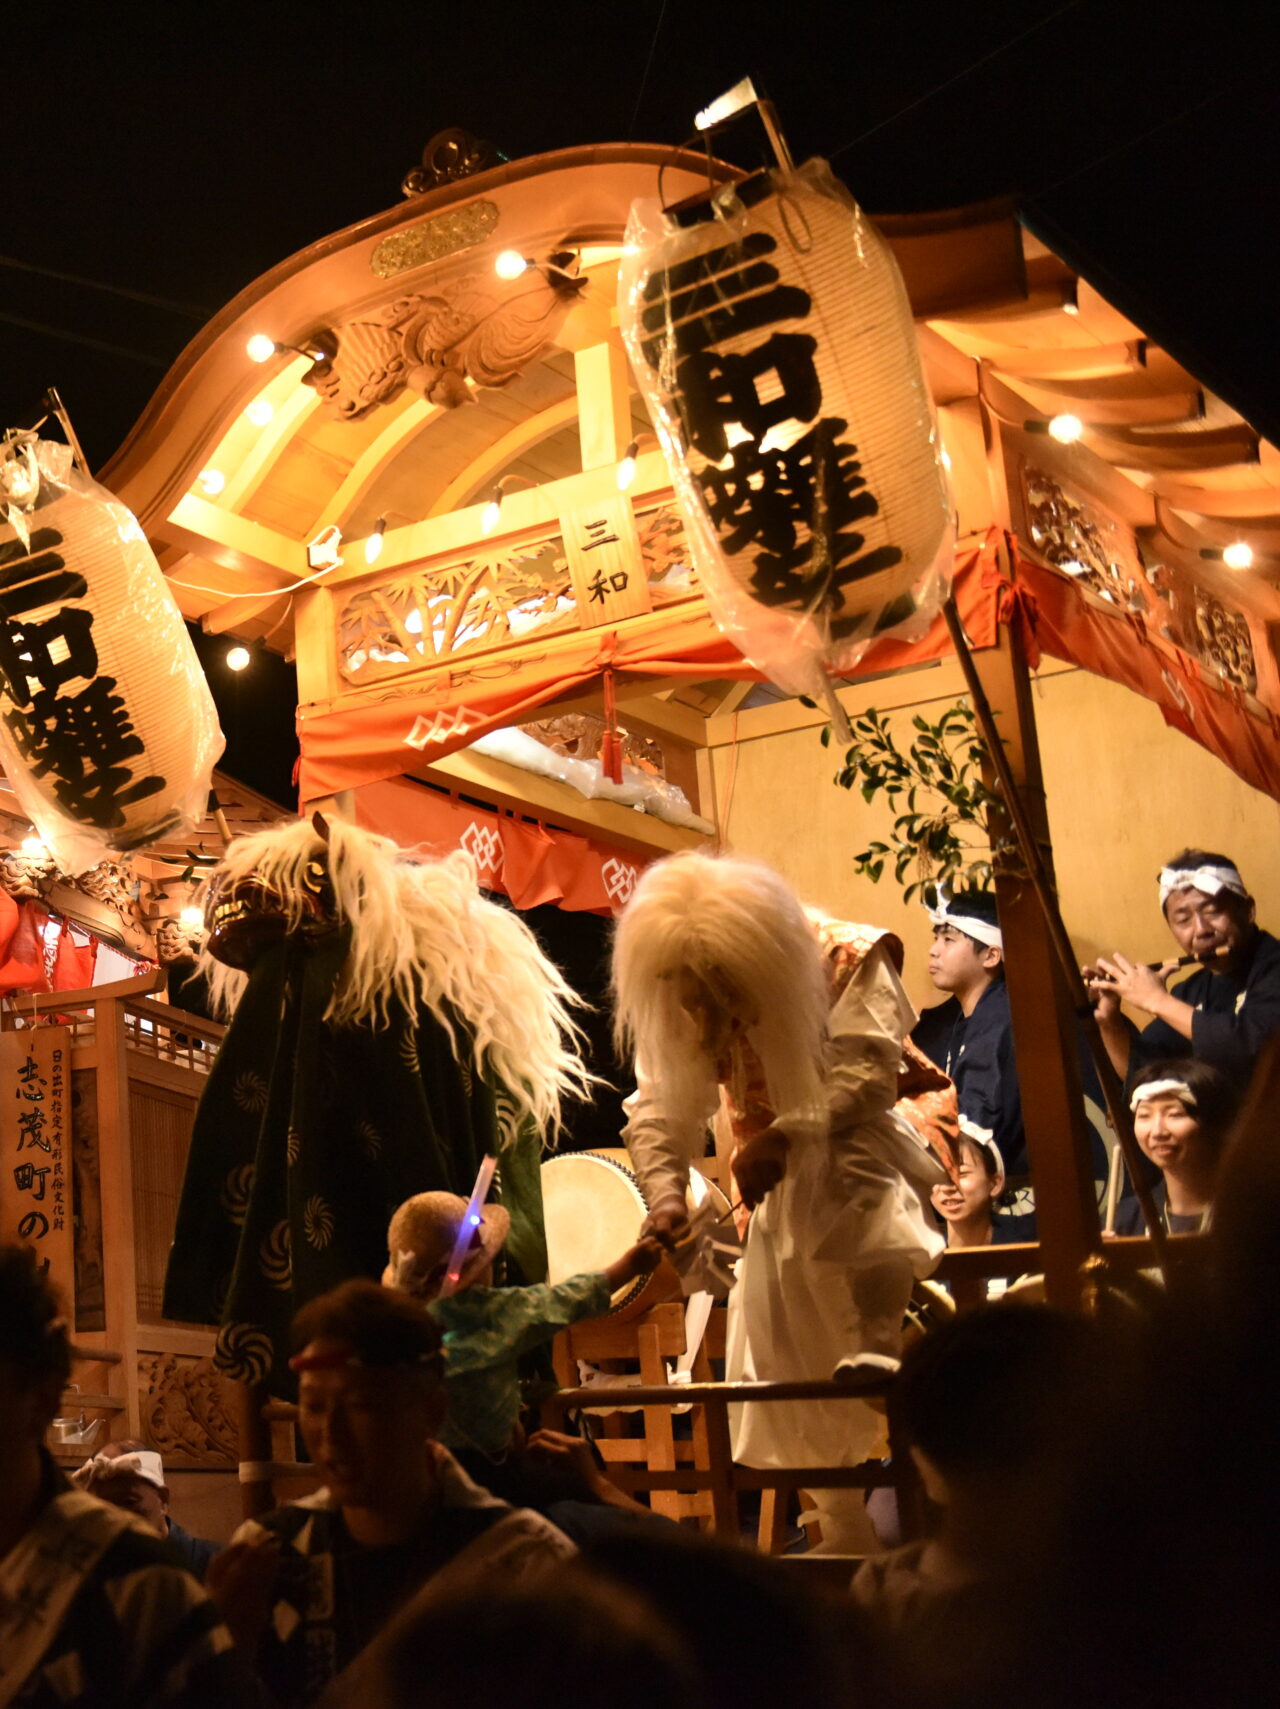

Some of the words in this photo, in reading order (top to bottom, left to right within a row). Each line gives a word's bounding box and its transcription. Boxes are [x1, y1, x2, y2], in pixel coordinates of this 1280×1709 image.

[581, 519, 628, 604] 三和
[13, 1056, 52, 1276] 志茂町の
